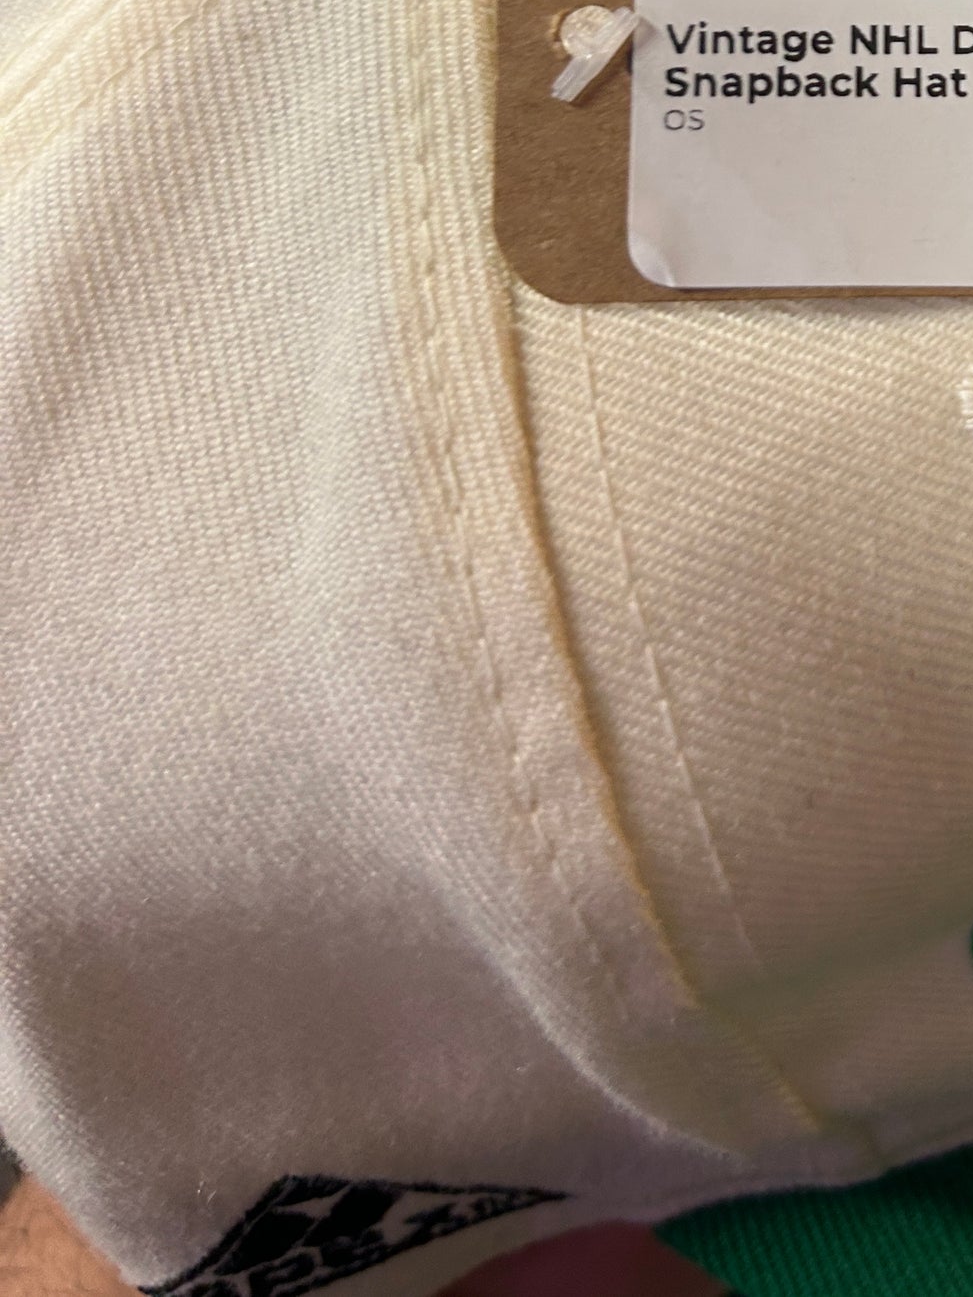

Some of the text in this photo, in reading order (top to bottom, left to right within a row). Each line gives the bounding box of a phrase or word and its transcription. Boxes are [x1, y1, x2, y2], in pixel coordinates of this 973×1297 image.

[666, 21, 835, 63] Vintage
[849, 24, 939, 56] NHL
[664, 66, 880, 104] Snapback
[893, 66, 969, 99] Hat
[663, 109, 705, 132] OS
